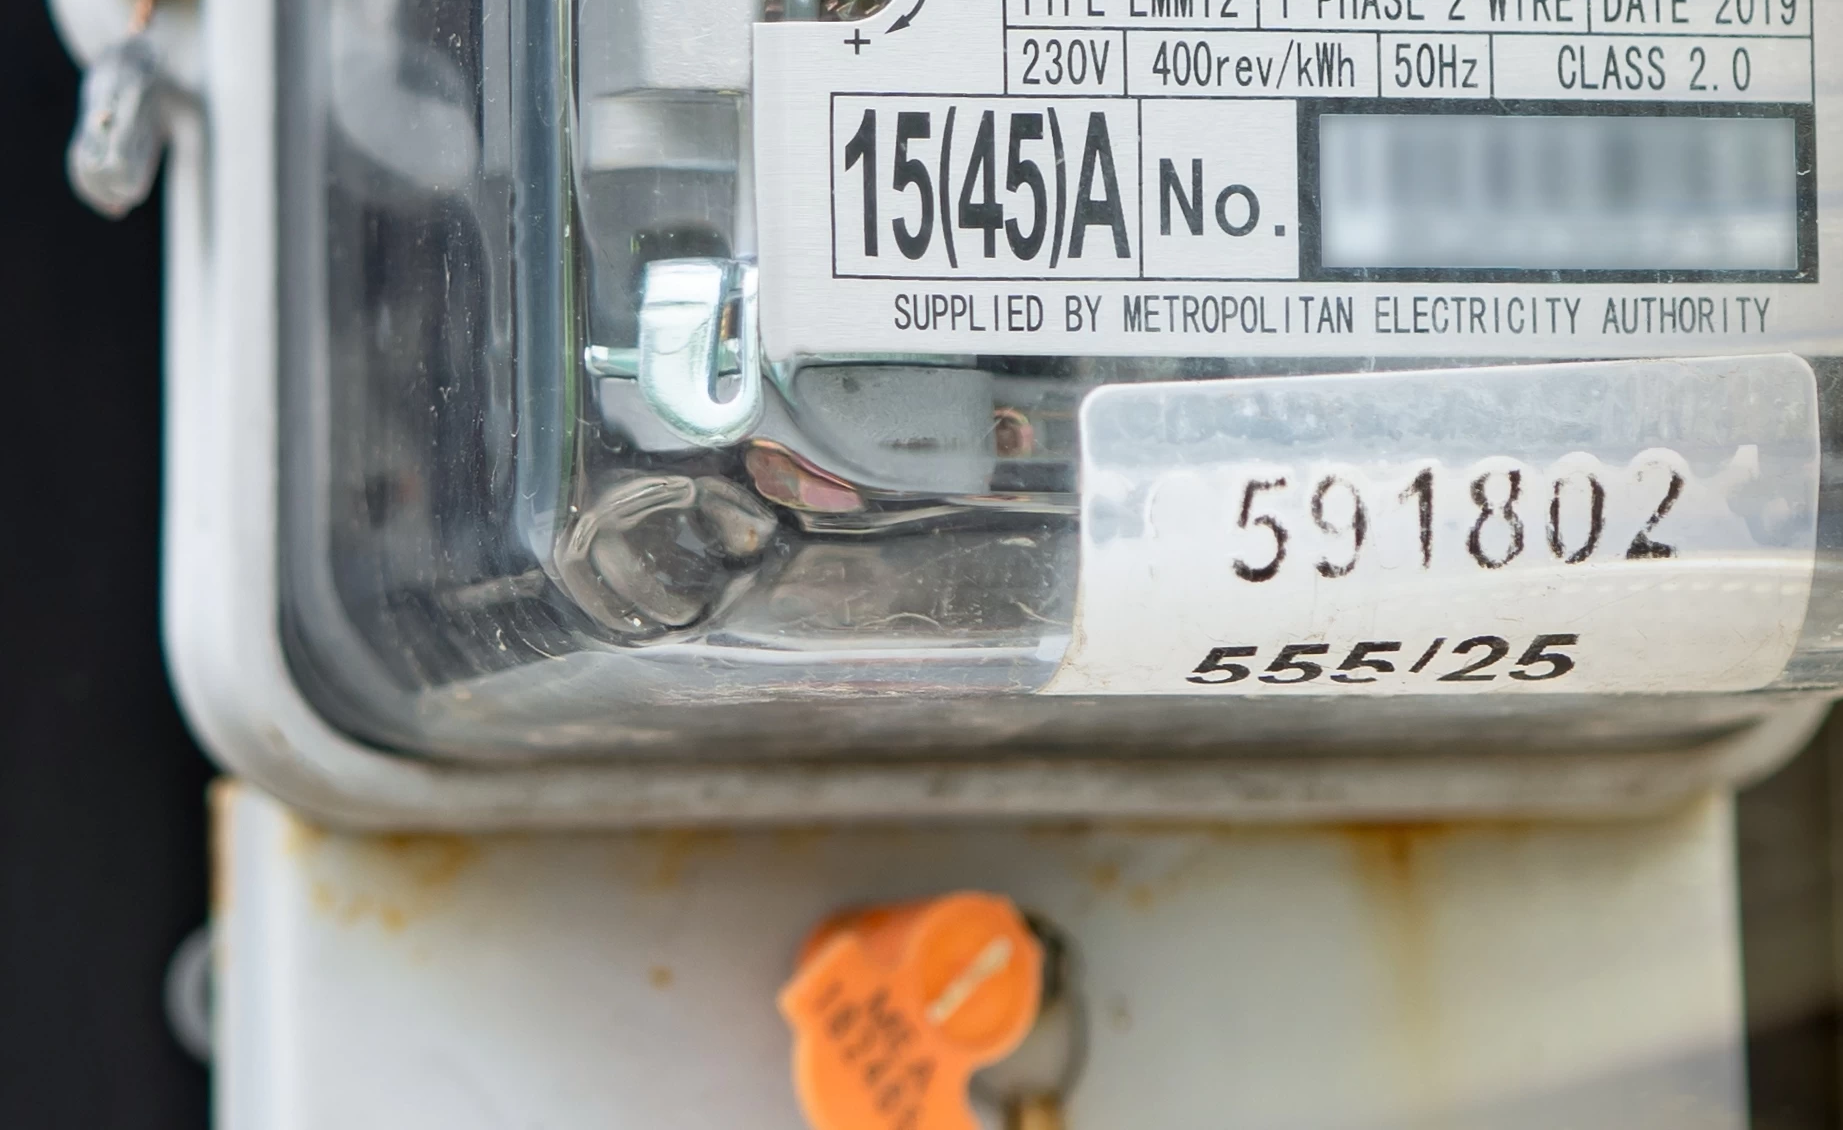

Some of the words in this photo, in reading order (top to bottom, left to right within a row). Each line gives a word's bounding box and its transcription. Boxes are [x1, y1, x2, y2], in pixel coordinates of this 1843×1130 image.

[1022, 38, 1110, 85] 230V
[1152, 39, 1355, 89] 400rev/kWh
[1395, 42, 1478, 88] 50Hz
[1557, 44, 1666, 91] CLASS
[1689, 46, 1751, 92] 2.0
[844, 105, 1131, 269] 15(45)A
[1159, 158, 1285, 237] No.
[894, 293, 1044, 332] SUPPLIED
[1065, 295, 1102, 332] BY
[1123, 294, 1353, 334] METROPOLITAN
[1375, 296, 1581, 335] ELECTRICITY
[1602, 296, 1770, 334] AUTHORITY
[1232, 465, 1685, 584] 591802
[1185, 633, 1579, 685] 555/25
